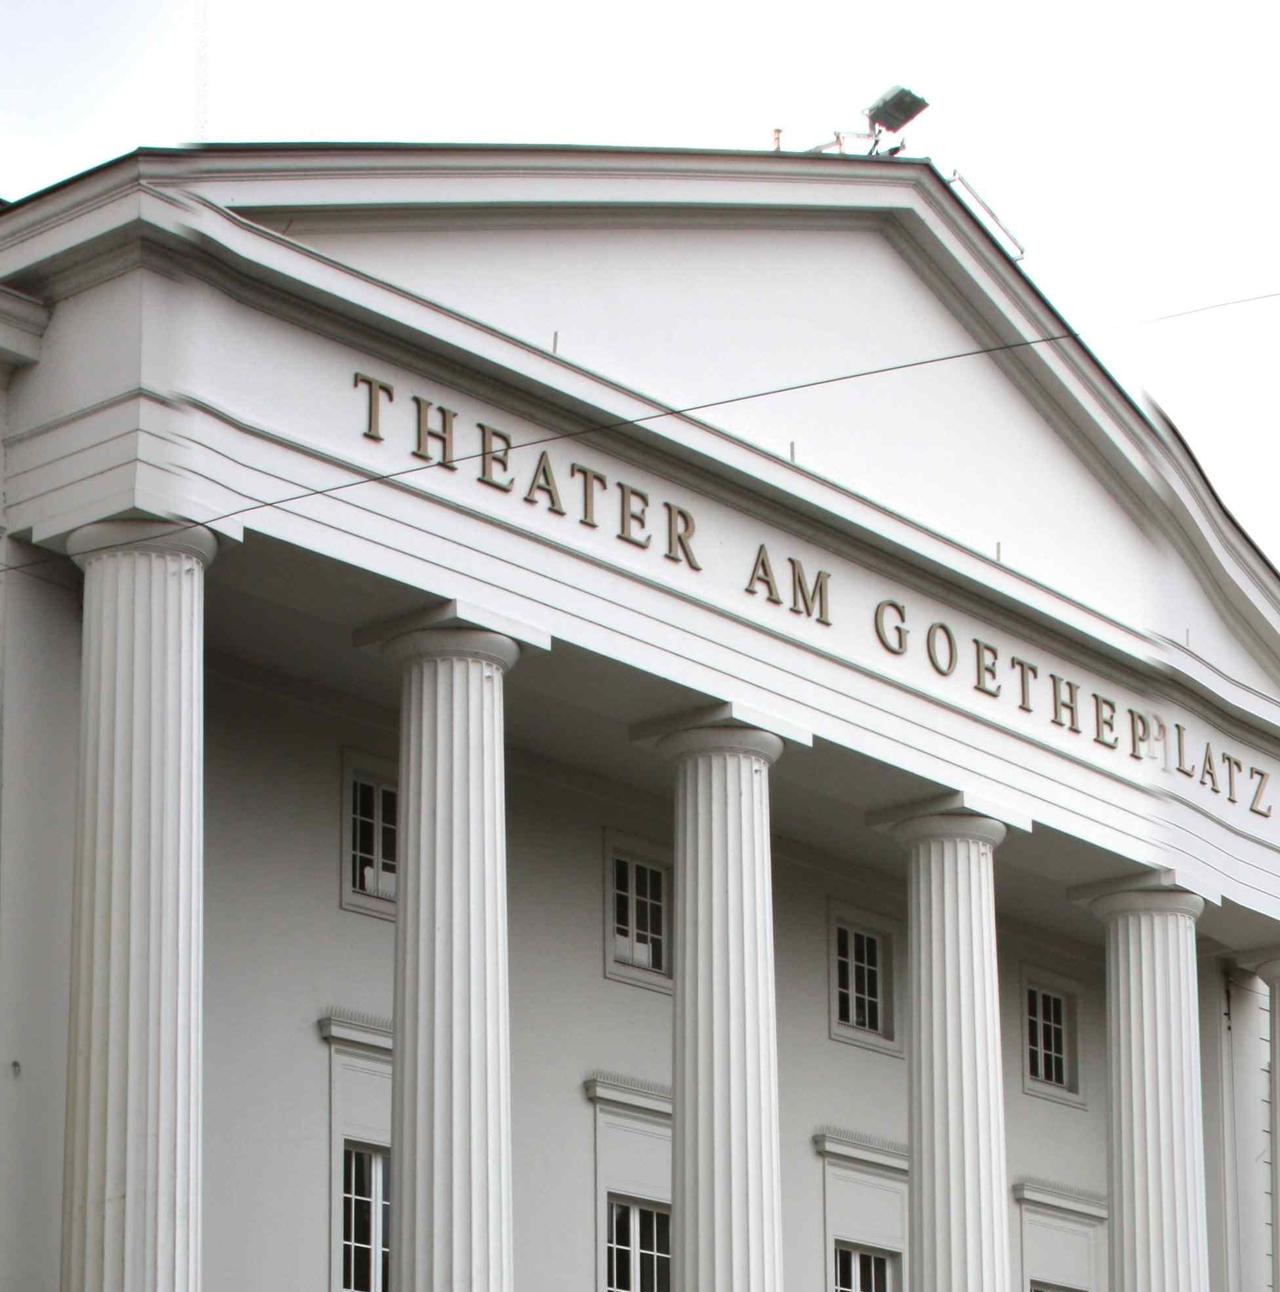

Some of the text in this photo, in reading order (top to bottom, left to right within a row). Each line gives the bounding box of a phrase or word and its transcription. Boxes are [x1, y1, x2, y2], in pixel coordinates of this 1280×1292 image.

[353, 371, 1273, 819] THEATER AM GOETHEPLATZ
